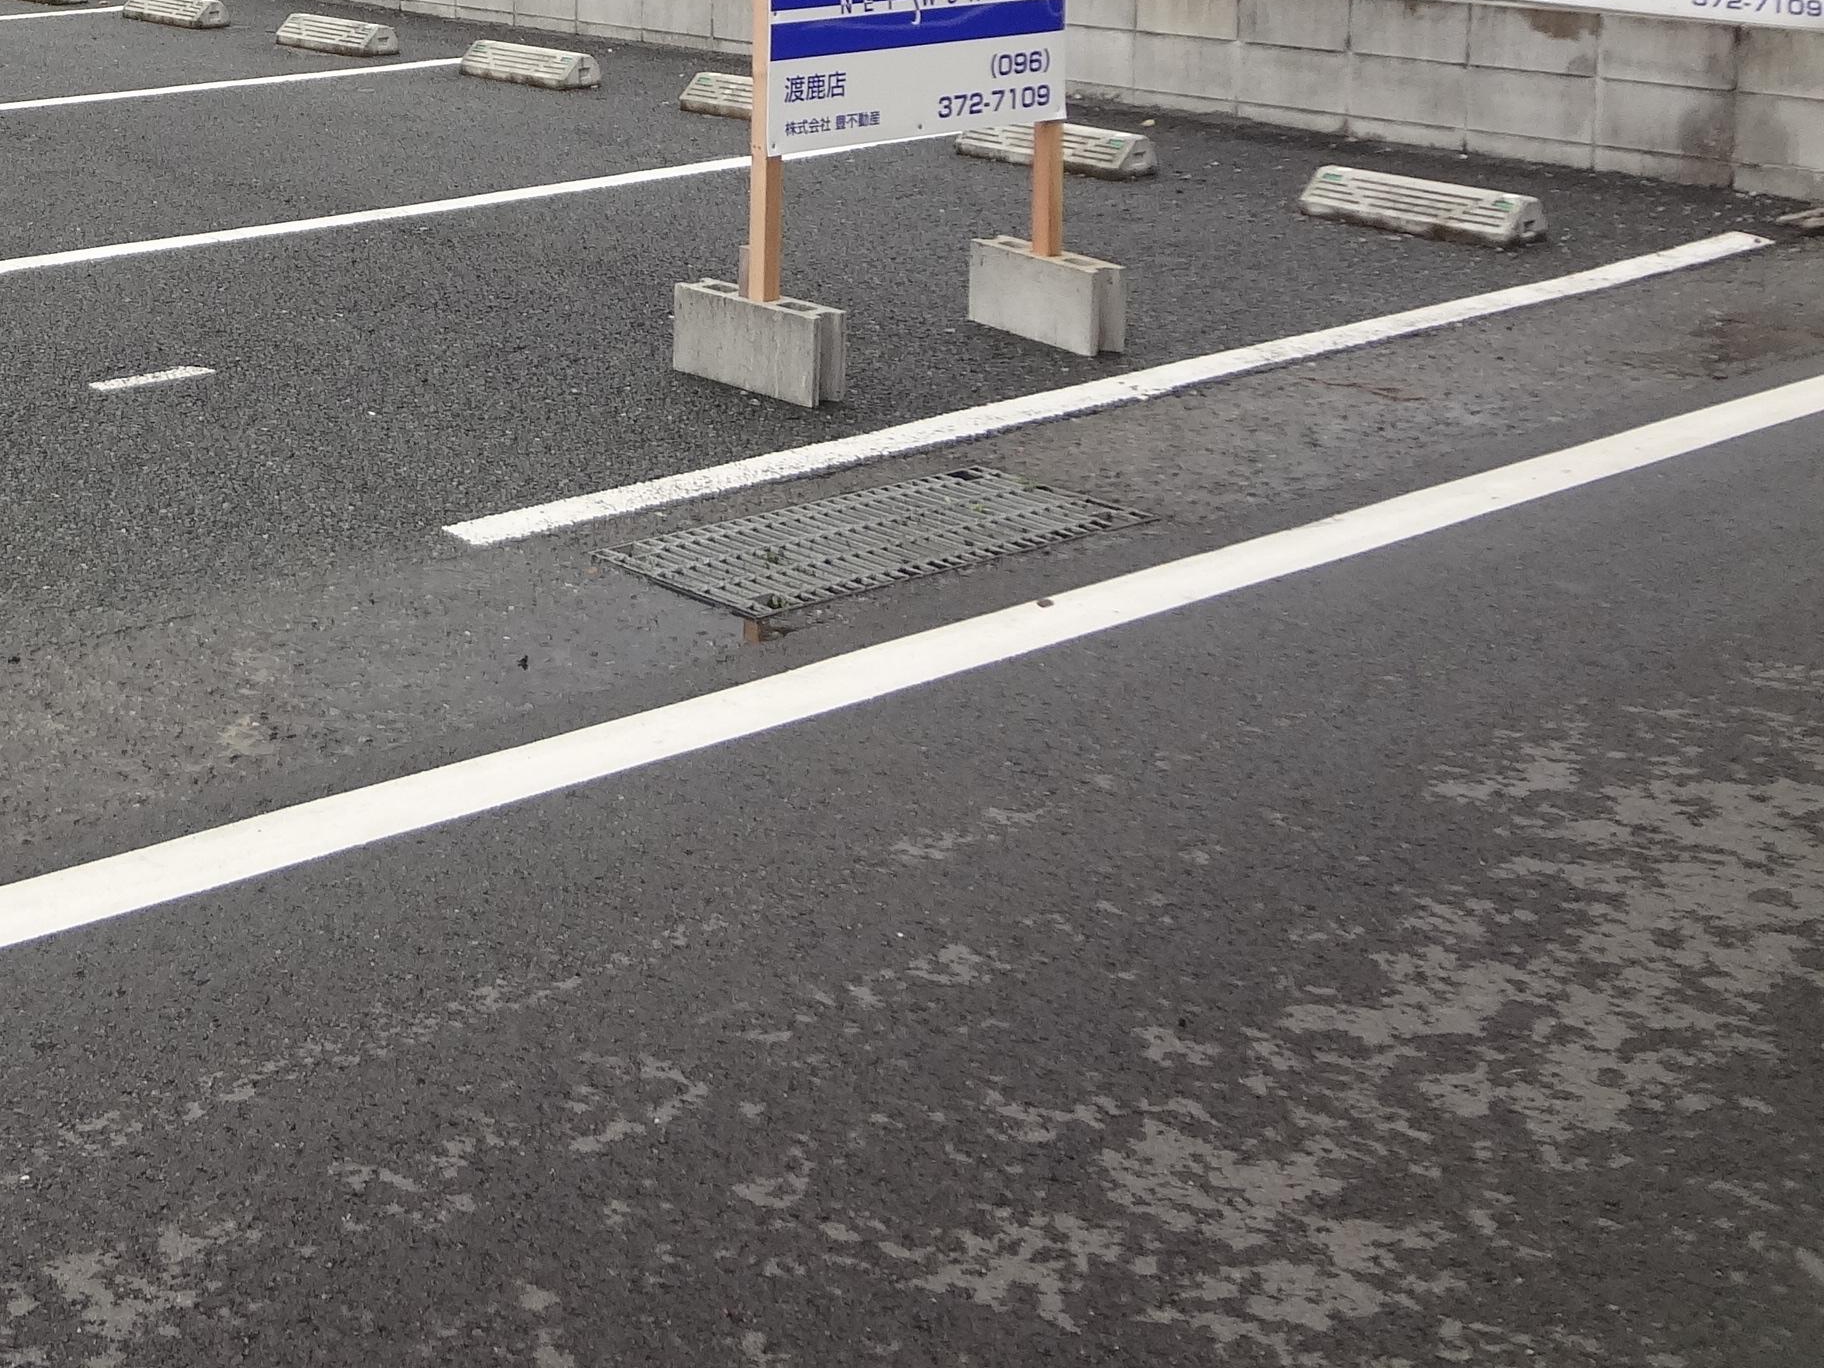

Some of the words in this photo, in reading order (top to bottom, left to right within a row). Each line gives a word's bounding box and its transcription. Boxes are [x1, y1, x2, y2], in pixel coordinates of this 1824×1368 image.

[991, 48, 1050, 78] (096)
[784, 72, 846, 103] 渡鹿店
[938, 84, 1050, 119] 372-7109
[785, 117, 831, 136] 株式会社
